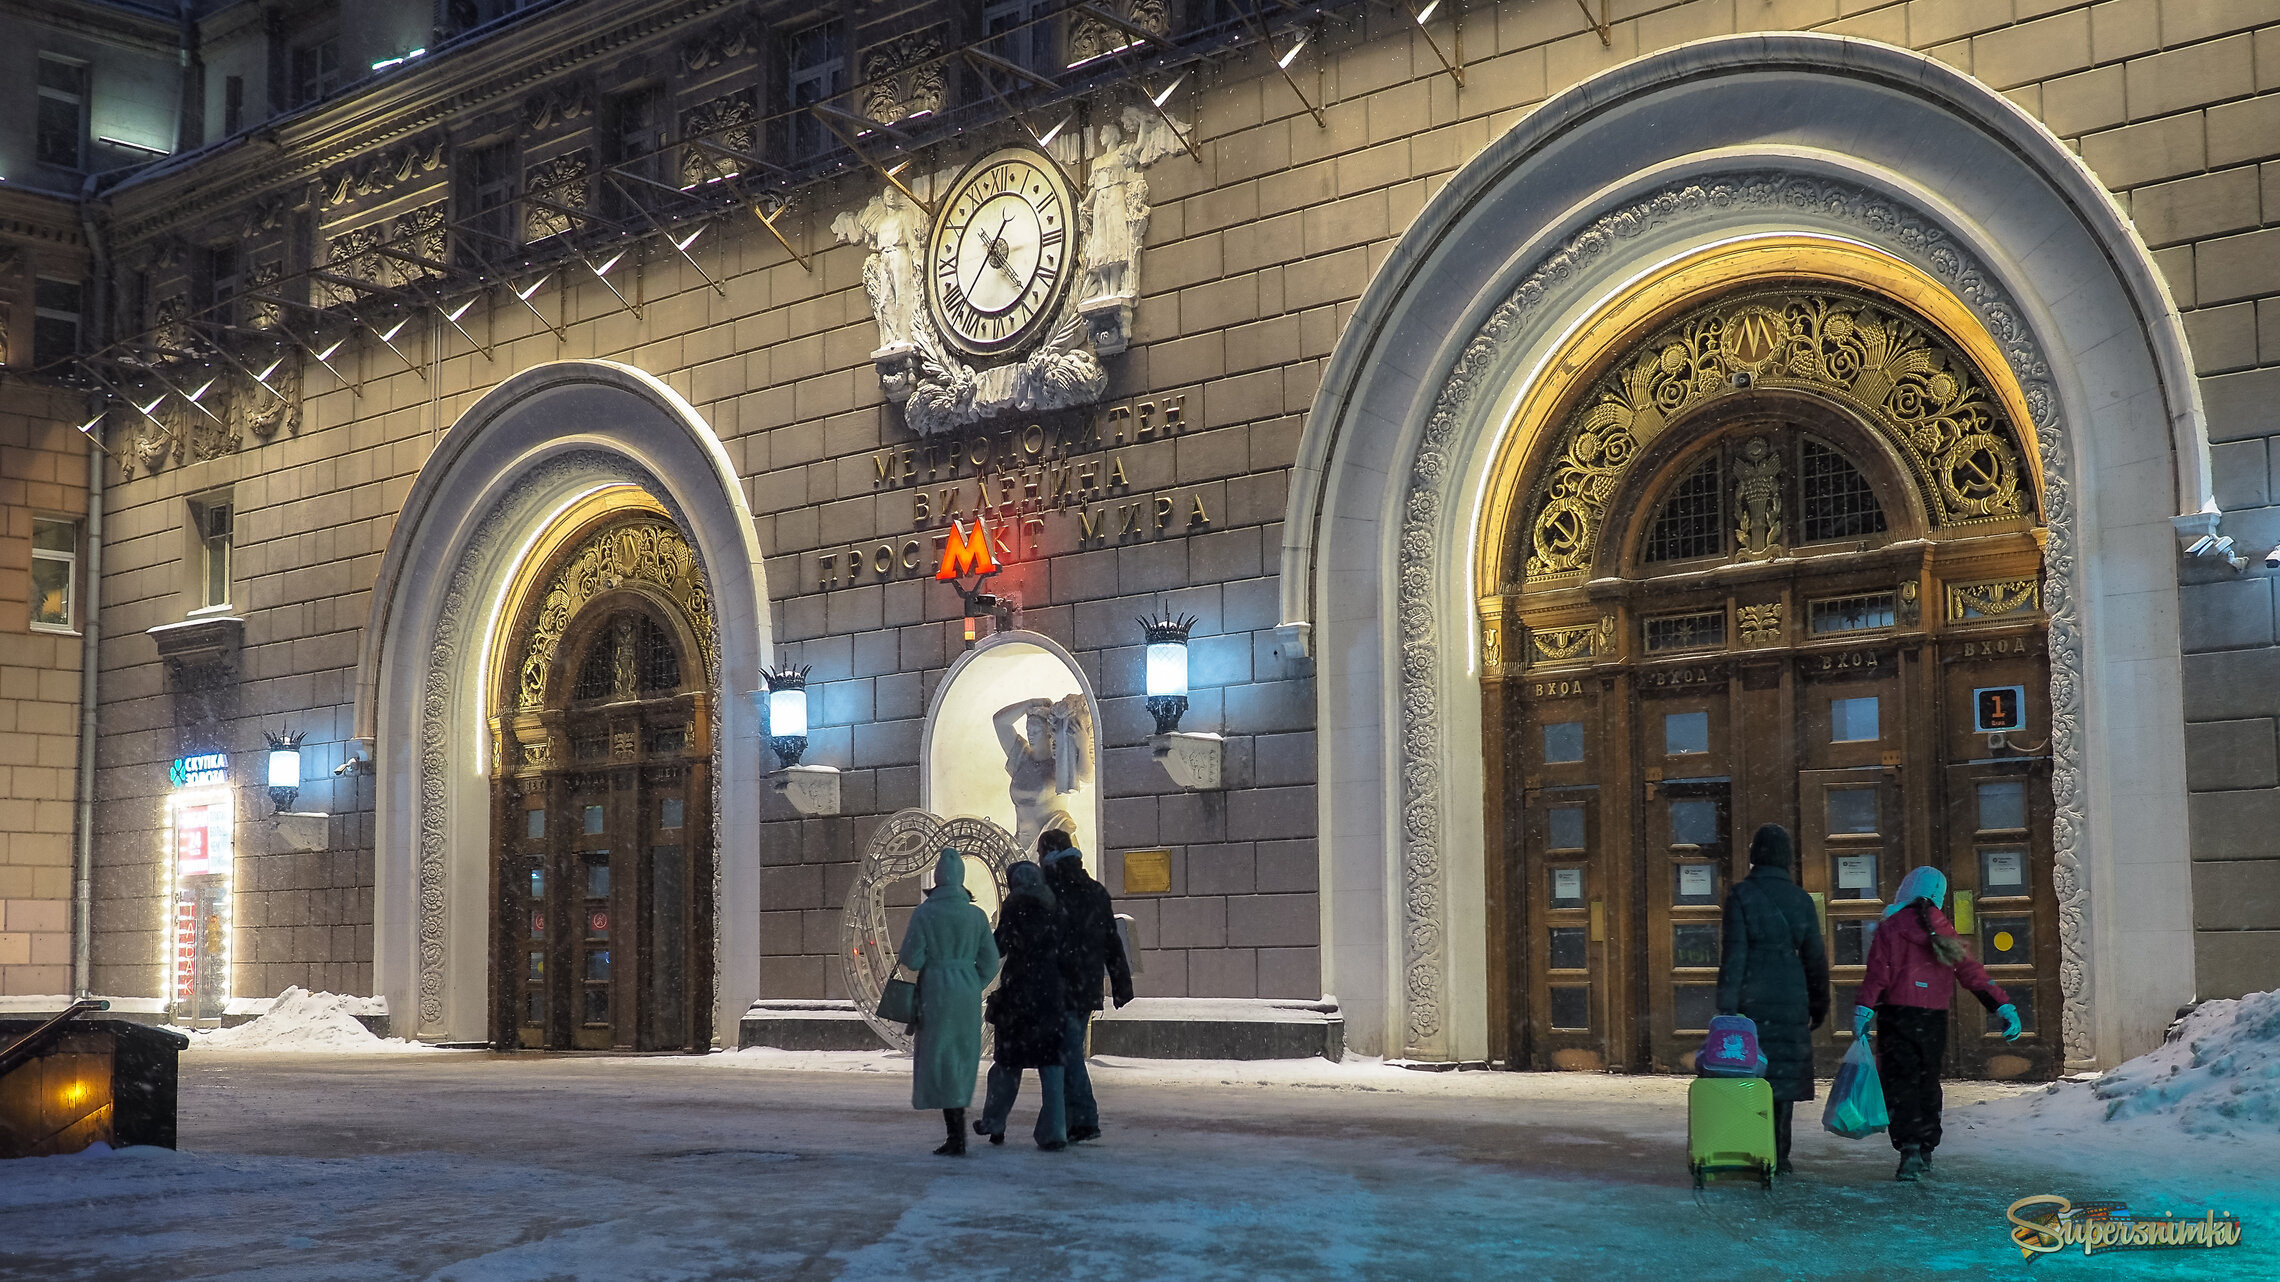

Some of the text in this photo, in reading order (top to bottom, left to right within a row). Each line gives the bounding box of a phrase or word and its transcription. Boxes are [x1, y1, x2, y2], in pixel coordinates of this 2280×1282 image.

[873, 394, 1186, 487] МЕТРОПОЛИТЕН
[1078, 493, 1211, 542] МИРА
[935, 516, 1002, 580] М
[1963, 637, 2026, 657] ВХОД
[1822, 651, 1878, 670] ВХОД
[1656, 669, 1708, 686] ВХОД
[1535, 680, 1583, 697] ВХОД
[1991, 695, 2006, 718] 1
[184, 753, 227, 772] СКУПКА
